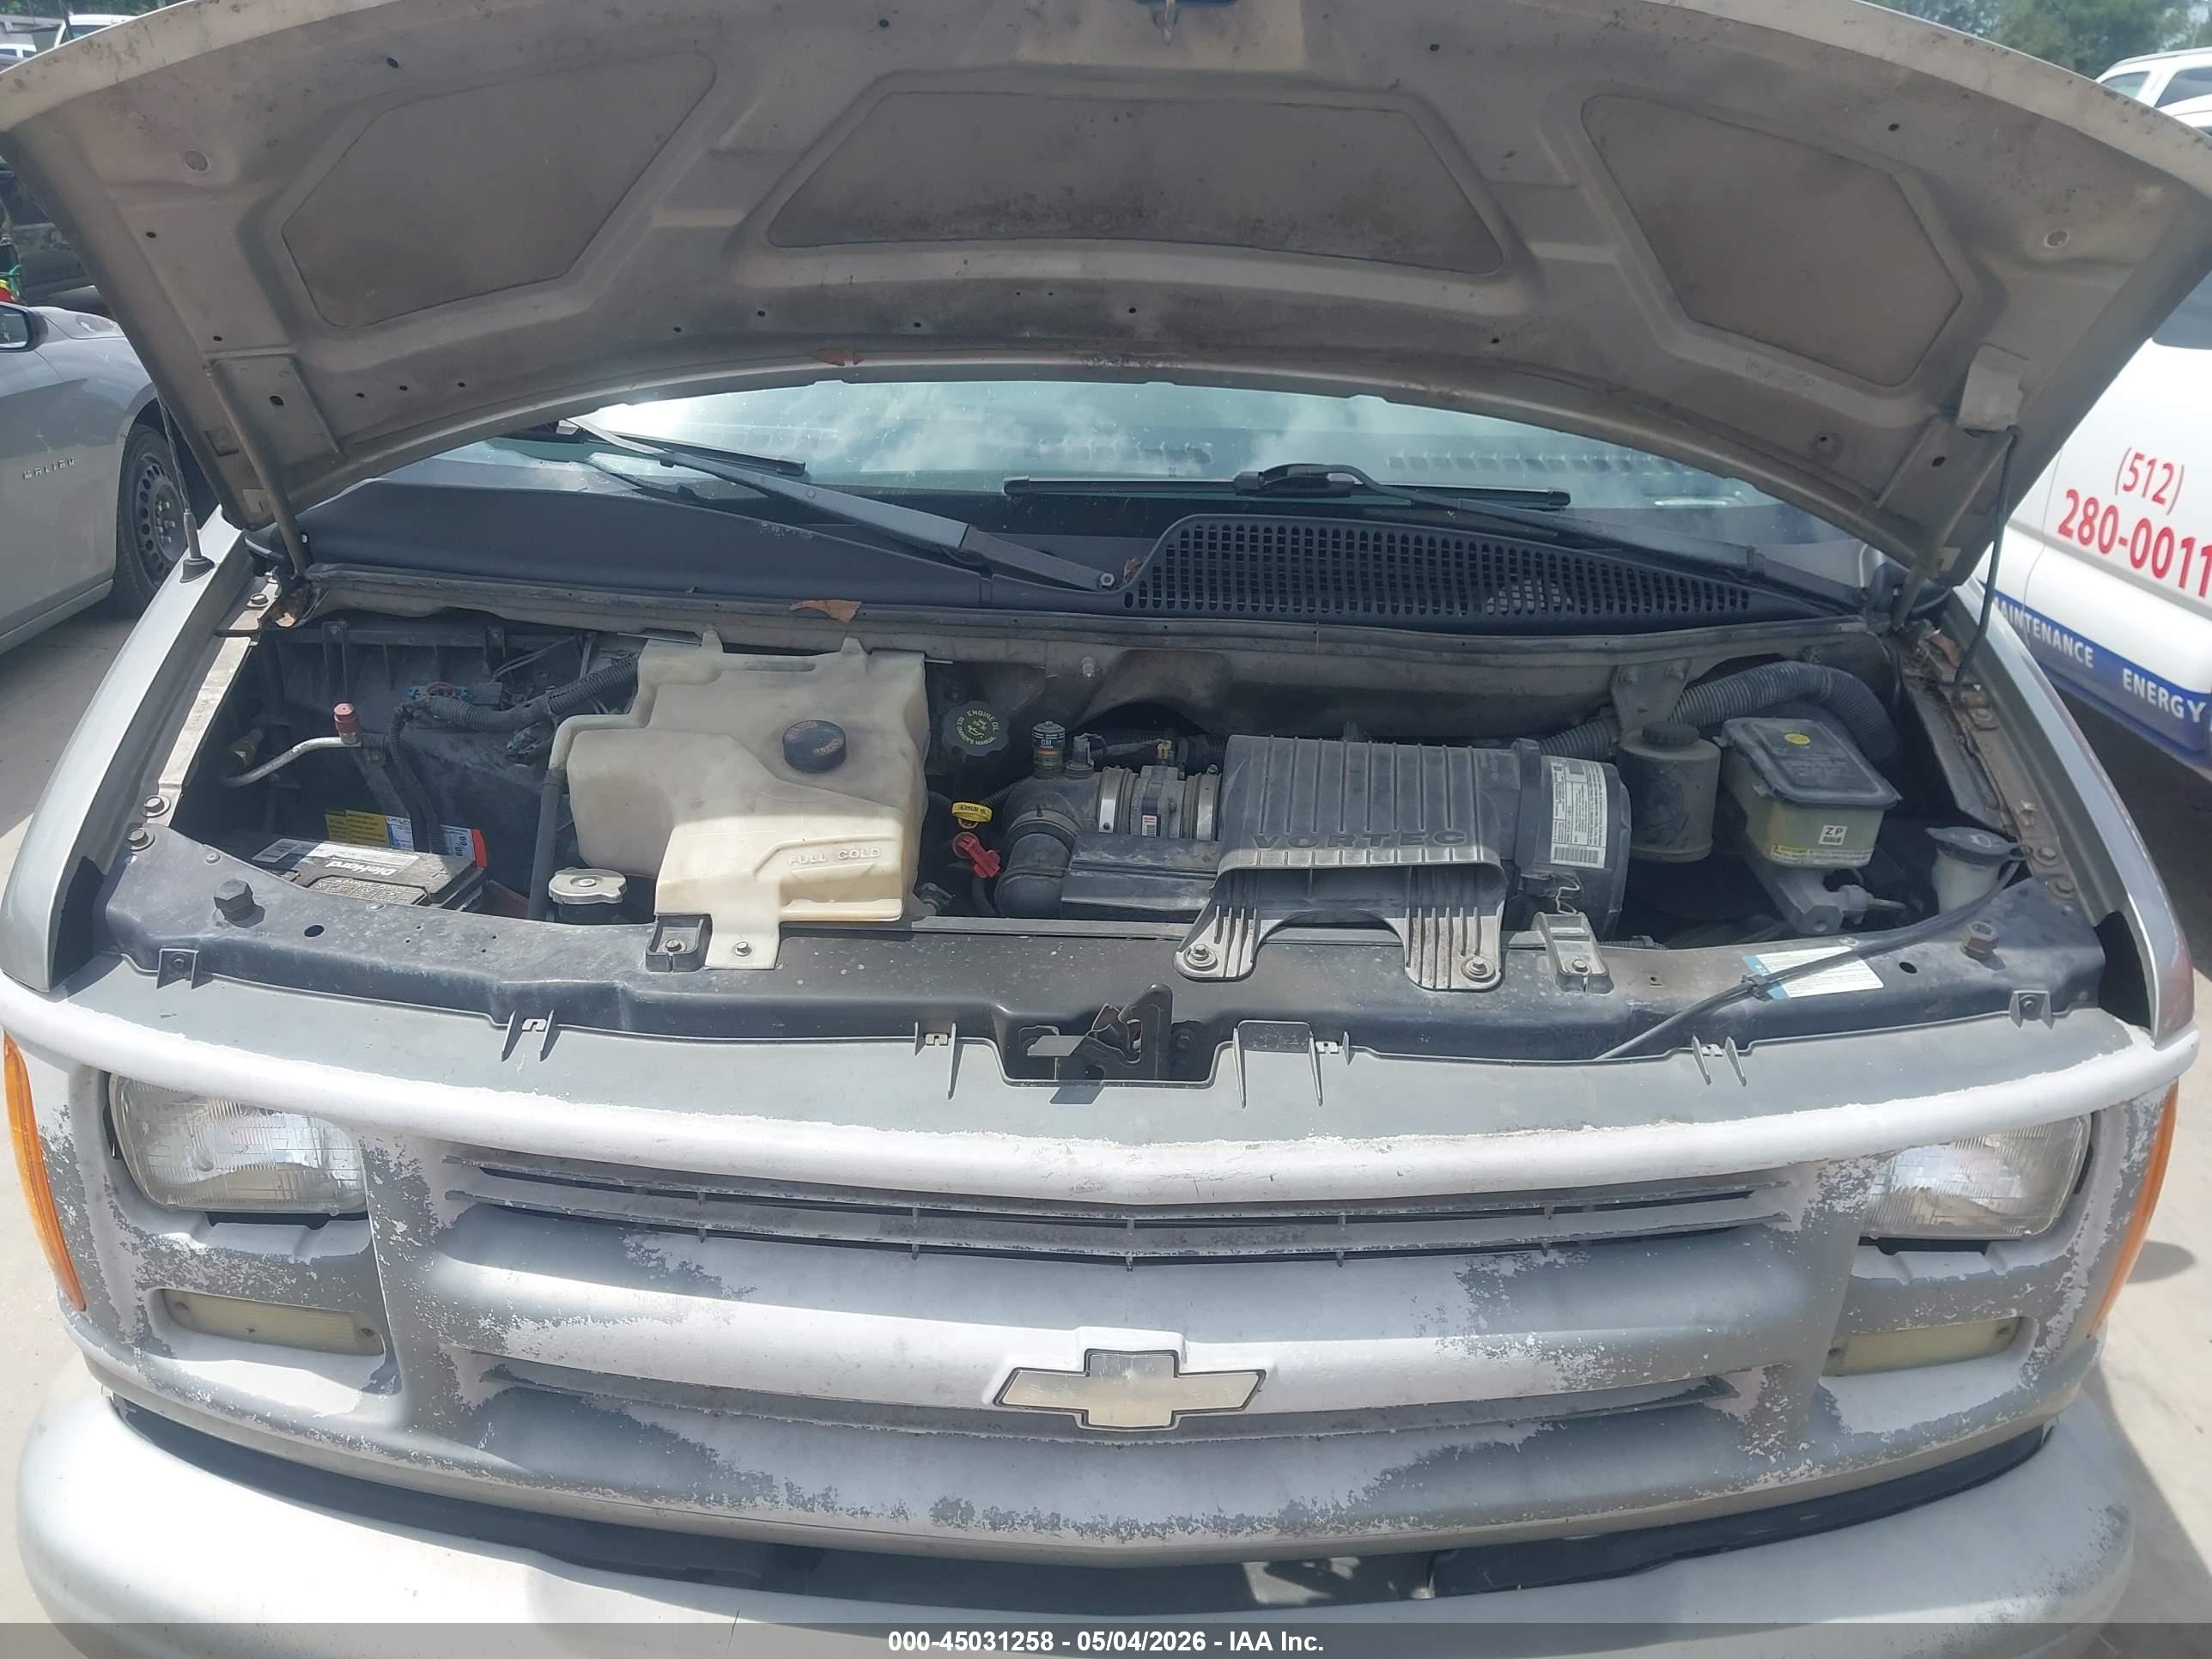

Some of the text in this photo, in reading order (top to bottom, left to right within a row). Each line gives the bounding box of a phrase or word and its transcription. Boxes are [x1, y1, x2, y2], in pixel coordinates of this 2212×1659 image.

[22, 456, 76, 481] MALIBU
[2115, 447, 2185, 515] (512)
[2057, 489, 2212, 599] 280-0011
[2122, 667, 2207, 723] ENERGY
[967, 709, 995, 722] ENGINE
[1253, 830, 1467, 848] VORTEC
[788, 848, 881, 866] FULL COLD
[324, 860, 398, 876] DieHard
